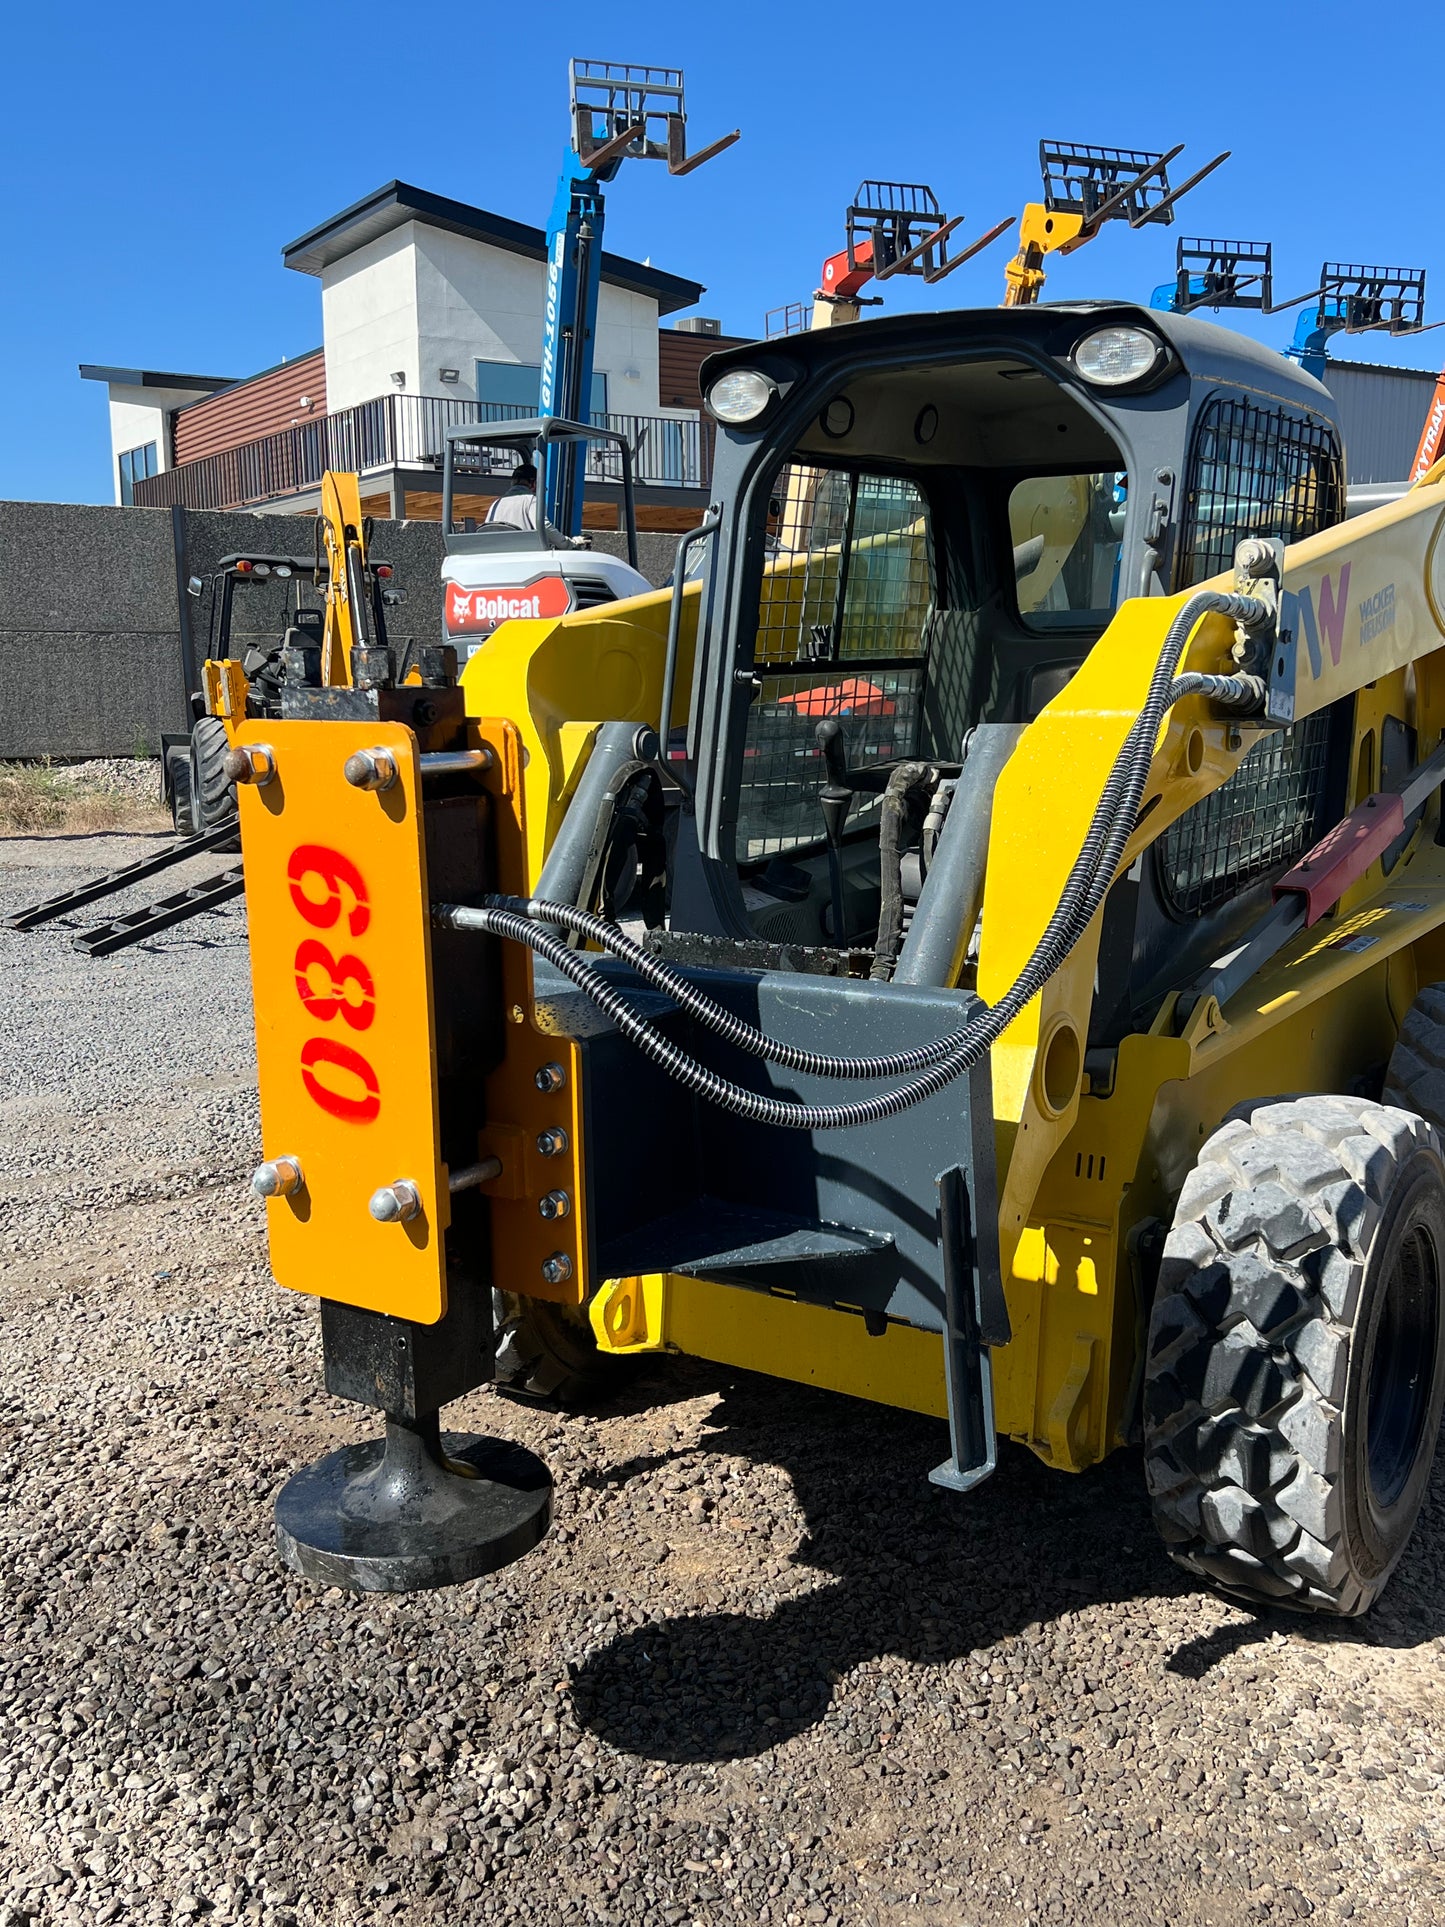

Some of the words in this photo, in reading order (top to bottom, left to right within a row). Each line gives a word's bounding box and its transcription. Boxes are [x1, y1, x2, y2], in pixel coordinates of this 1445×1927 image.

[541, 261, 558, 408] GTH-1056
[1413, 397, 1445, 482] KYTRAK
[475, 595, 540, 620] Bobcat
[1359, 583, 1395, 622] WACKER
[1360, 604, 1395, 647] NEUSON
[287, 844, 381, 1127] 680
